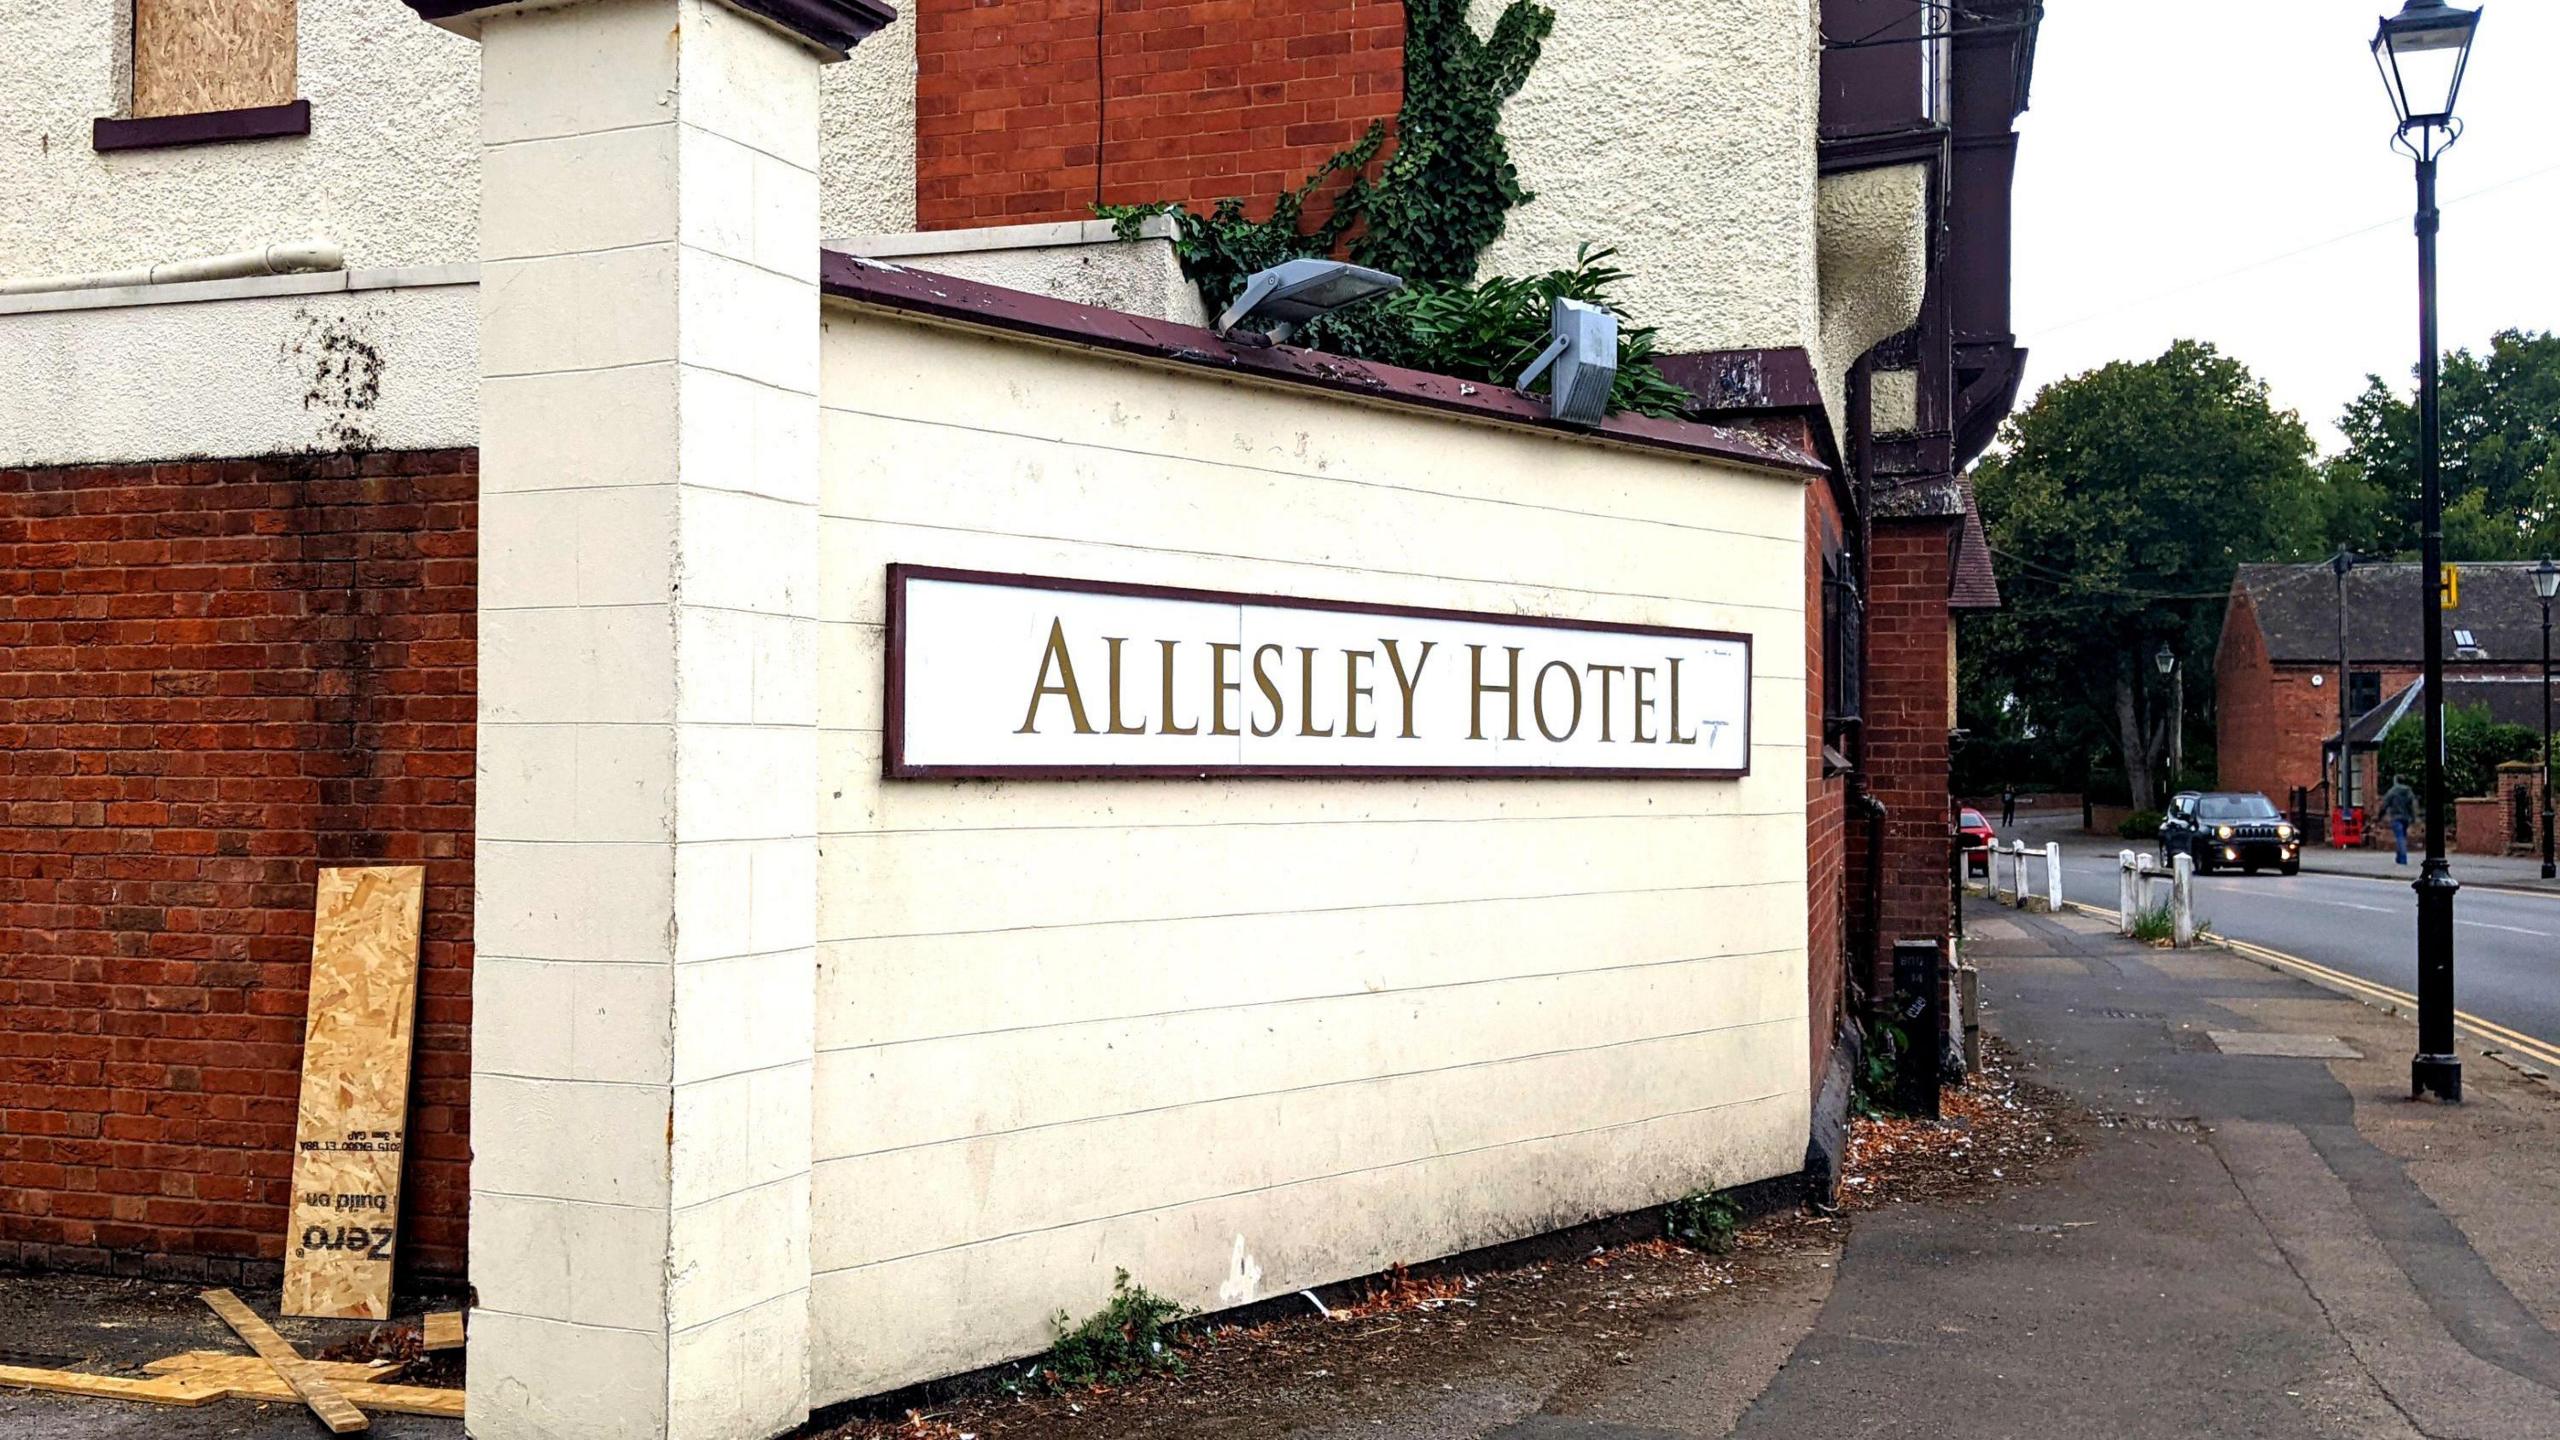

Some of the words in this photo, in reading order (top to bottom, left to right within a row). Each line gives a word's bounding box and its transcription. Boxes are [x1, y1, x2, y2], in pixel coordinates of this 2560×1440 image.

[1013, 615, 1438, 740] ALLESLEY
[1465, 644, 1698, 745] HOTEL
[348, 1131, 367, 1141] GAP
[335, 1193, 387, 1213] build
[302, 1225, 394, 1261] Zero
